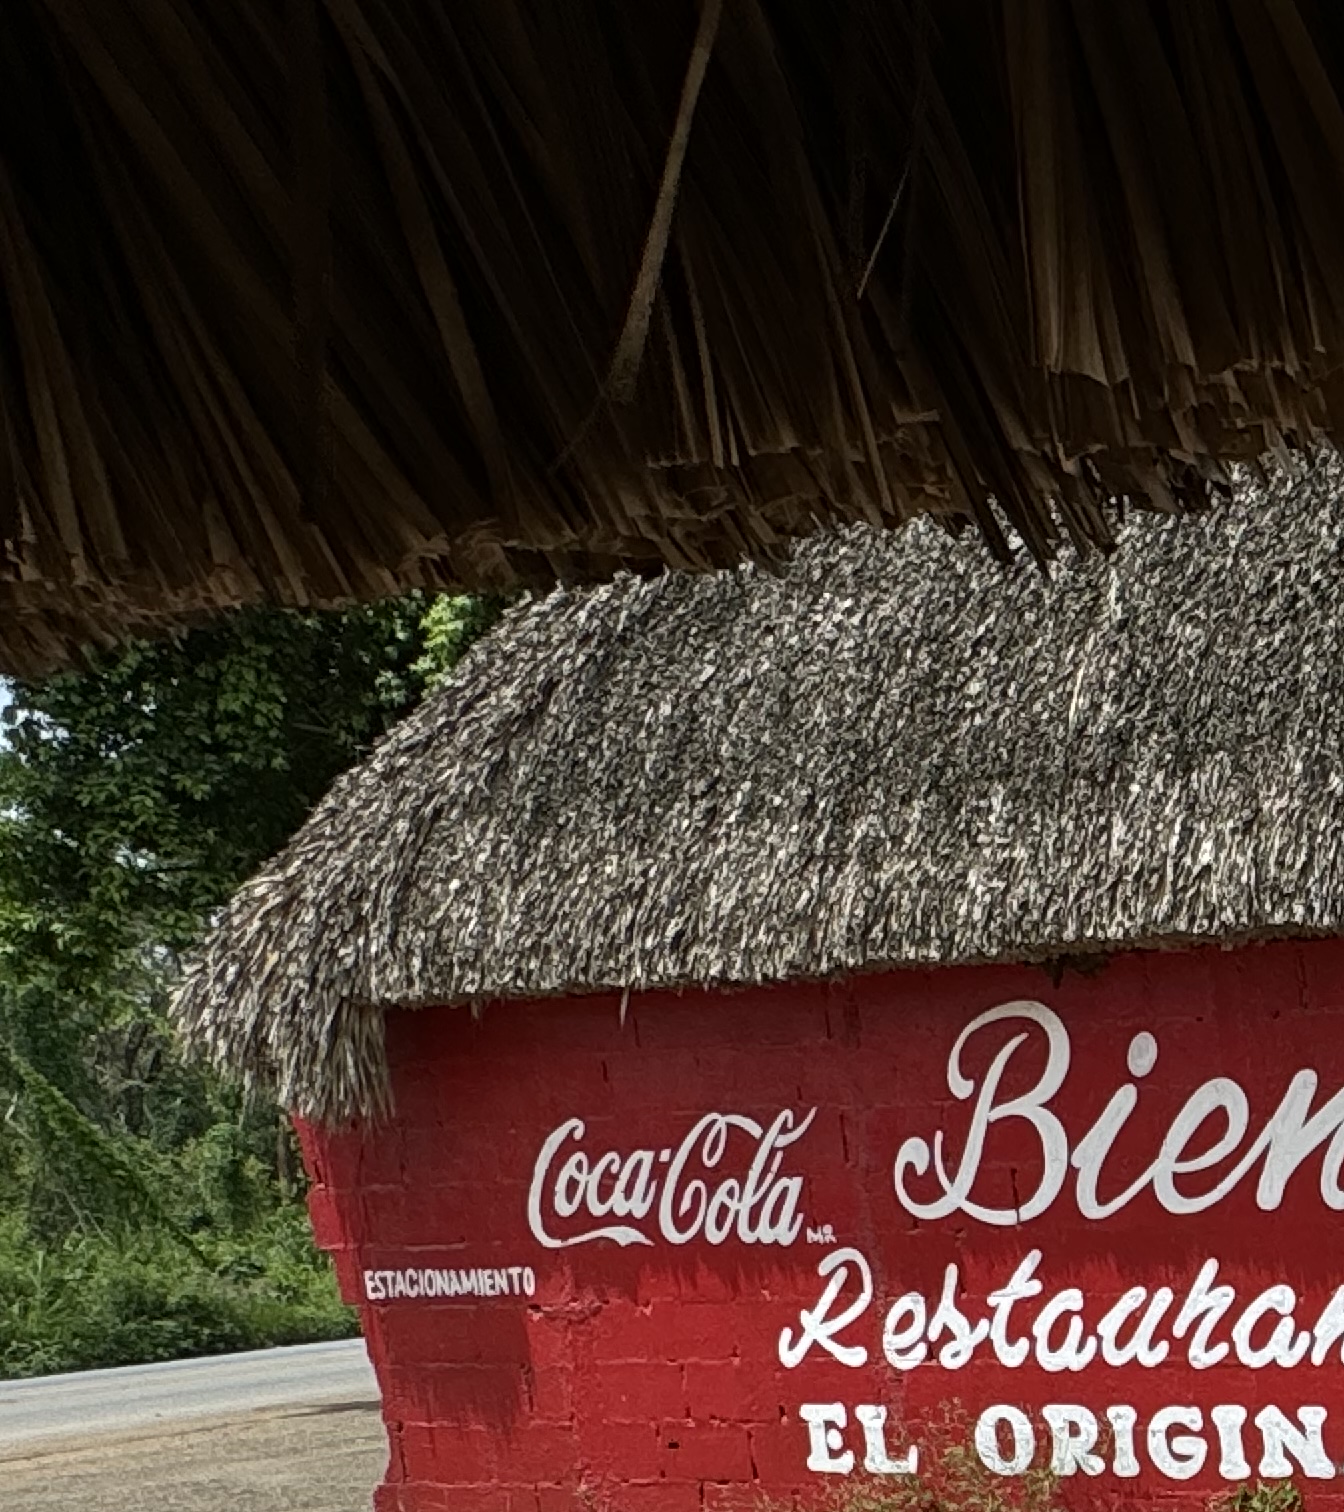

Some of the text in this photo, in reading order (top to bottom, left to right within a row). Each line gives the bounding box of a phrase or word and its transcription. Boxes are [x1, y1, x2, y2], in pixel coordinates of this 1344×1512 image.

[527, 1107, 817, 1248] Coca-Cola
[363, 1266, 536, 1300] ESTACIONAMIENTO
[799, 1402, 919, 1477] EL
